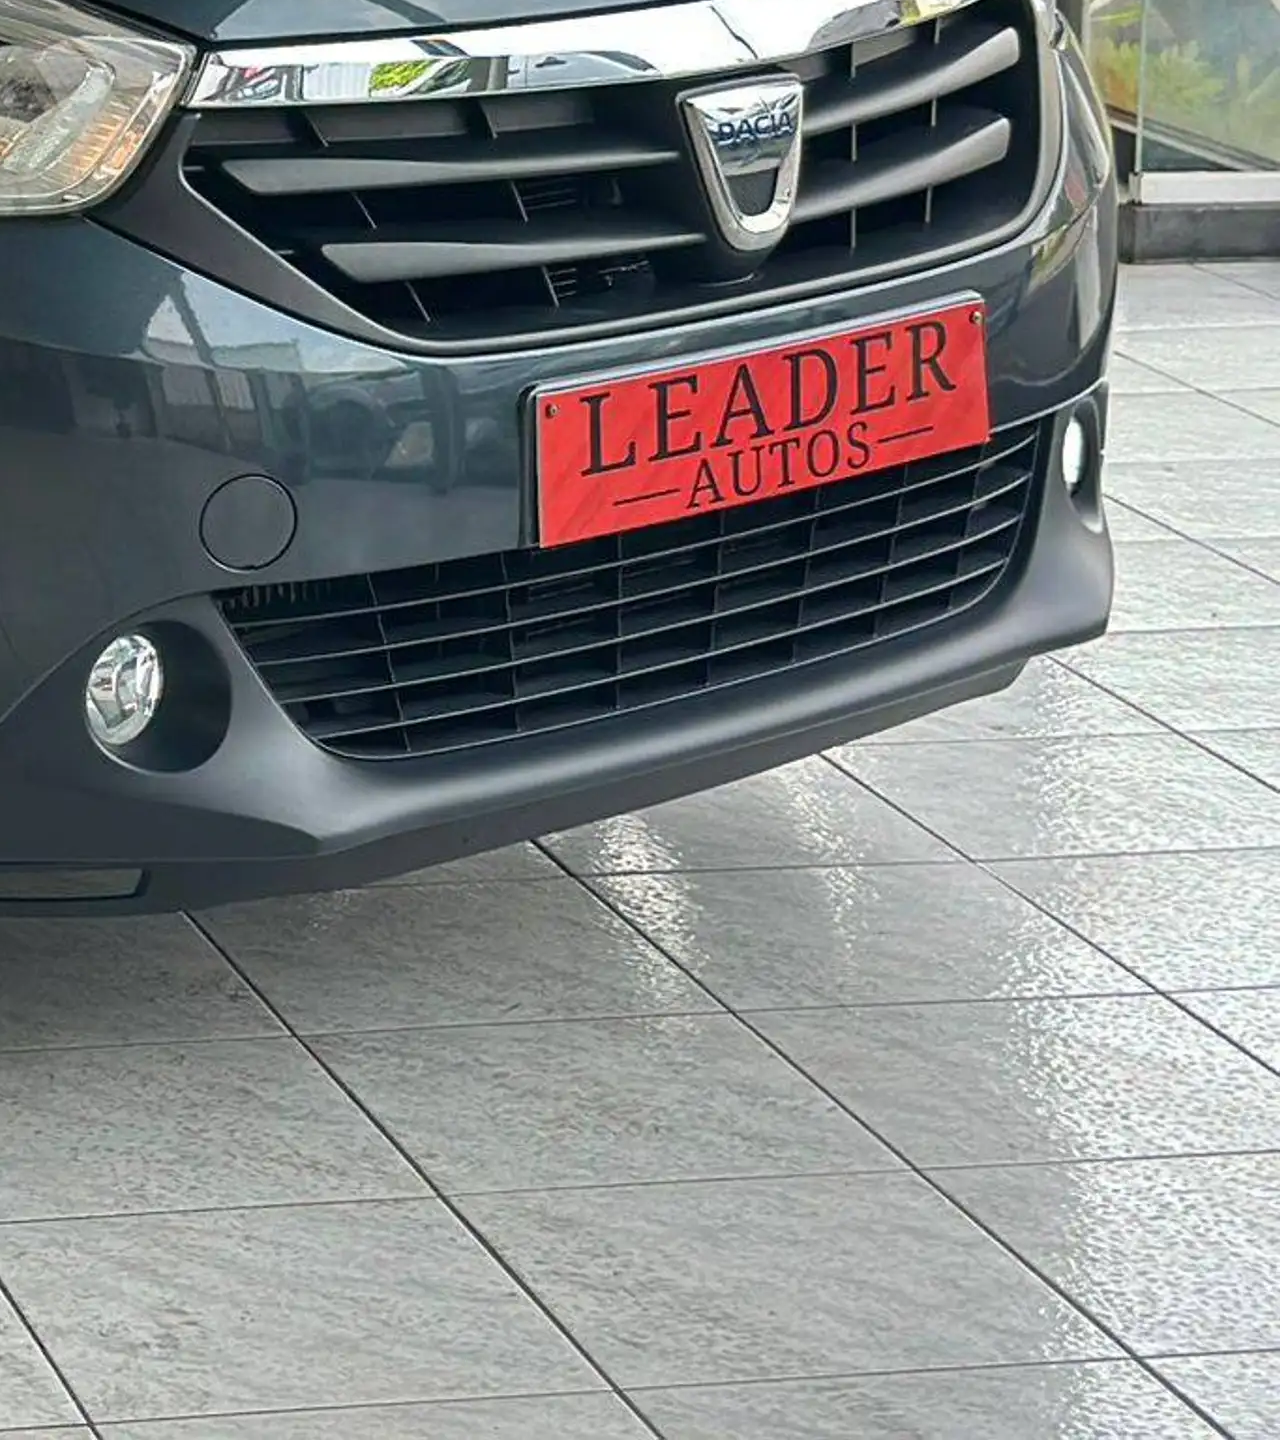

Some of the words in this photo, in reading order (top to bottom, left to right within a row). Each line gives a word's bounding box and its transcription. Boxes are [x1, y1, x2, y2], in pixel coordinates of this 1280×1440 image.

[716, 112, 793, 143] DACIA
[579, 320, 957, 478] LEADER
[686, 421, 874, 509] AUTOS
